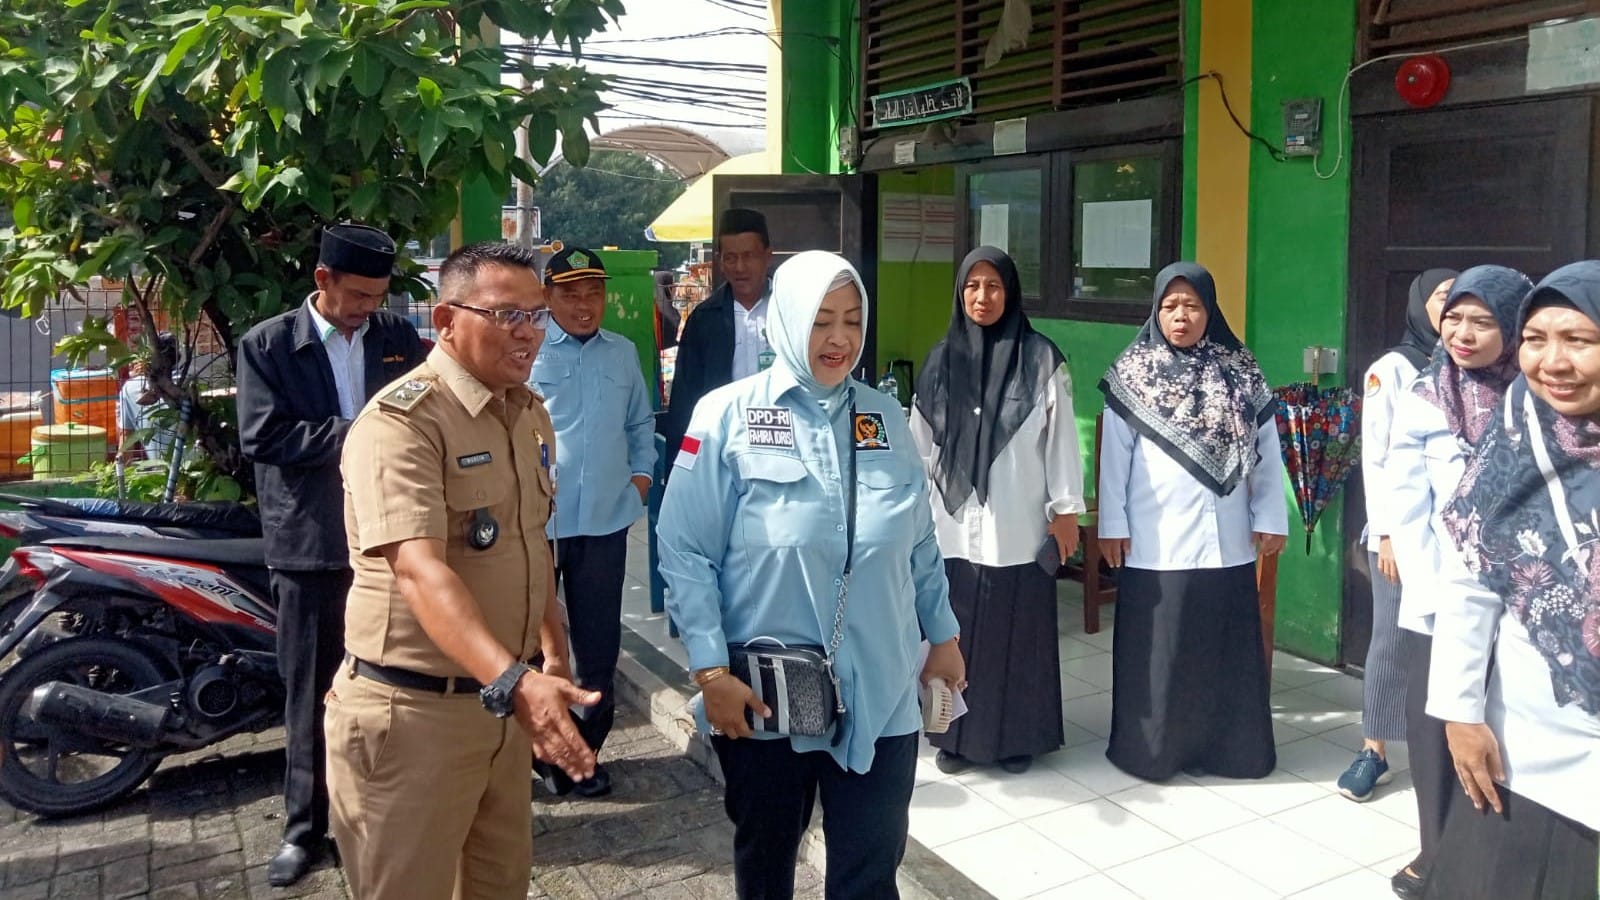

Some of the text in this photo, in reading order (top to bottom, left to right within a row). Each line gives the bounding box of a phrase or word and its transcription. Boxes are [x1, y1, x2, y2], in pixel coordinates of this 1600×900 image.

[748, 410, 789, 425] DPD-RI
[749, 429, 792, 446] FAHIRA IDRIS
